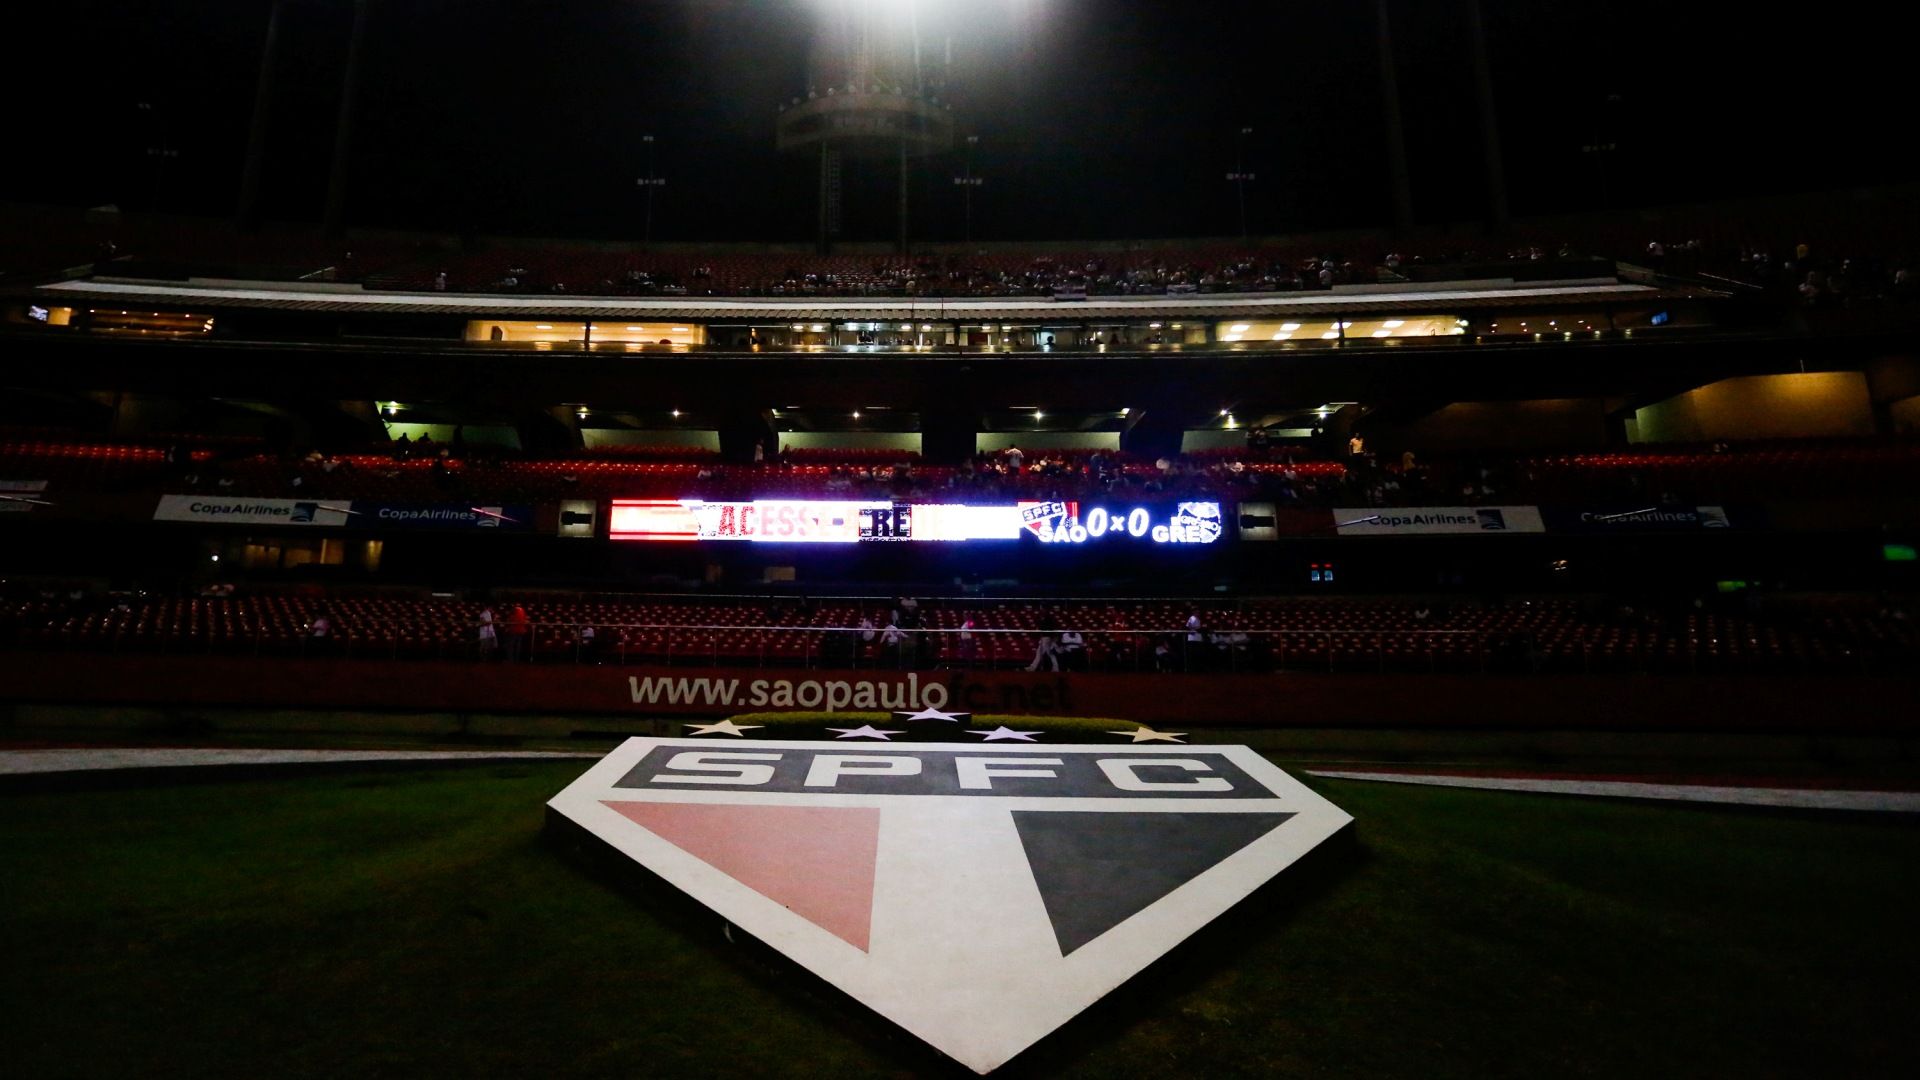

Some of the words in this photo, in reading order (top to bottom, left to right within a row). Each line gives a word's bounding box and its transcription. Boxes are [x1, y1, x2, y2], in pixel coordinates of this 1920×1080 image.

[190, 502, 290, 516] CopaAirlines
[378, 507, 477, 521] CopaAirlines
[650, 750, 1234, 792] SPFC
